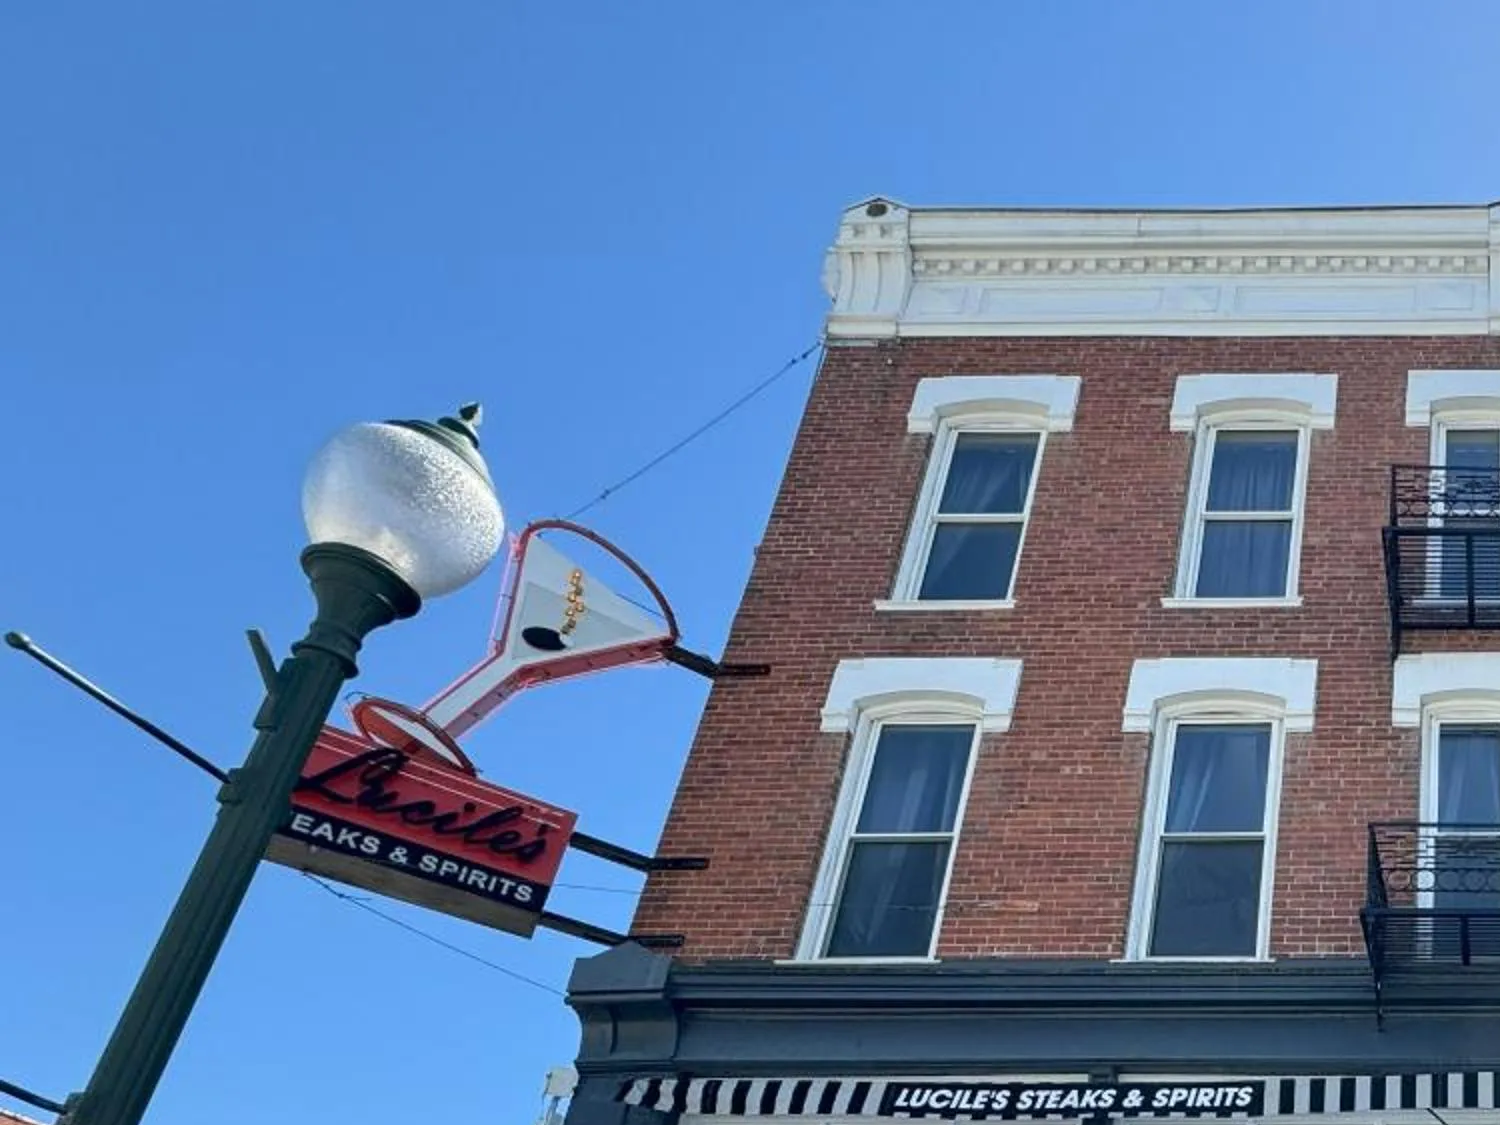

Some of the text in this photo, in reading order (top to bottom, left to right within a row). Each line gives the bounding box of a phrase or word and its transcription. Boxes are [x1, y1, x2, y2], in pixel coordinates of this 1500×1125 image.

[291, 747, 547, 863] Lucile's
[290, 811, 534, 903] EAKS & SPIRITS
[895, 1086, 1254, 1110] LUCILE'S STEAKS & SPIRITS
